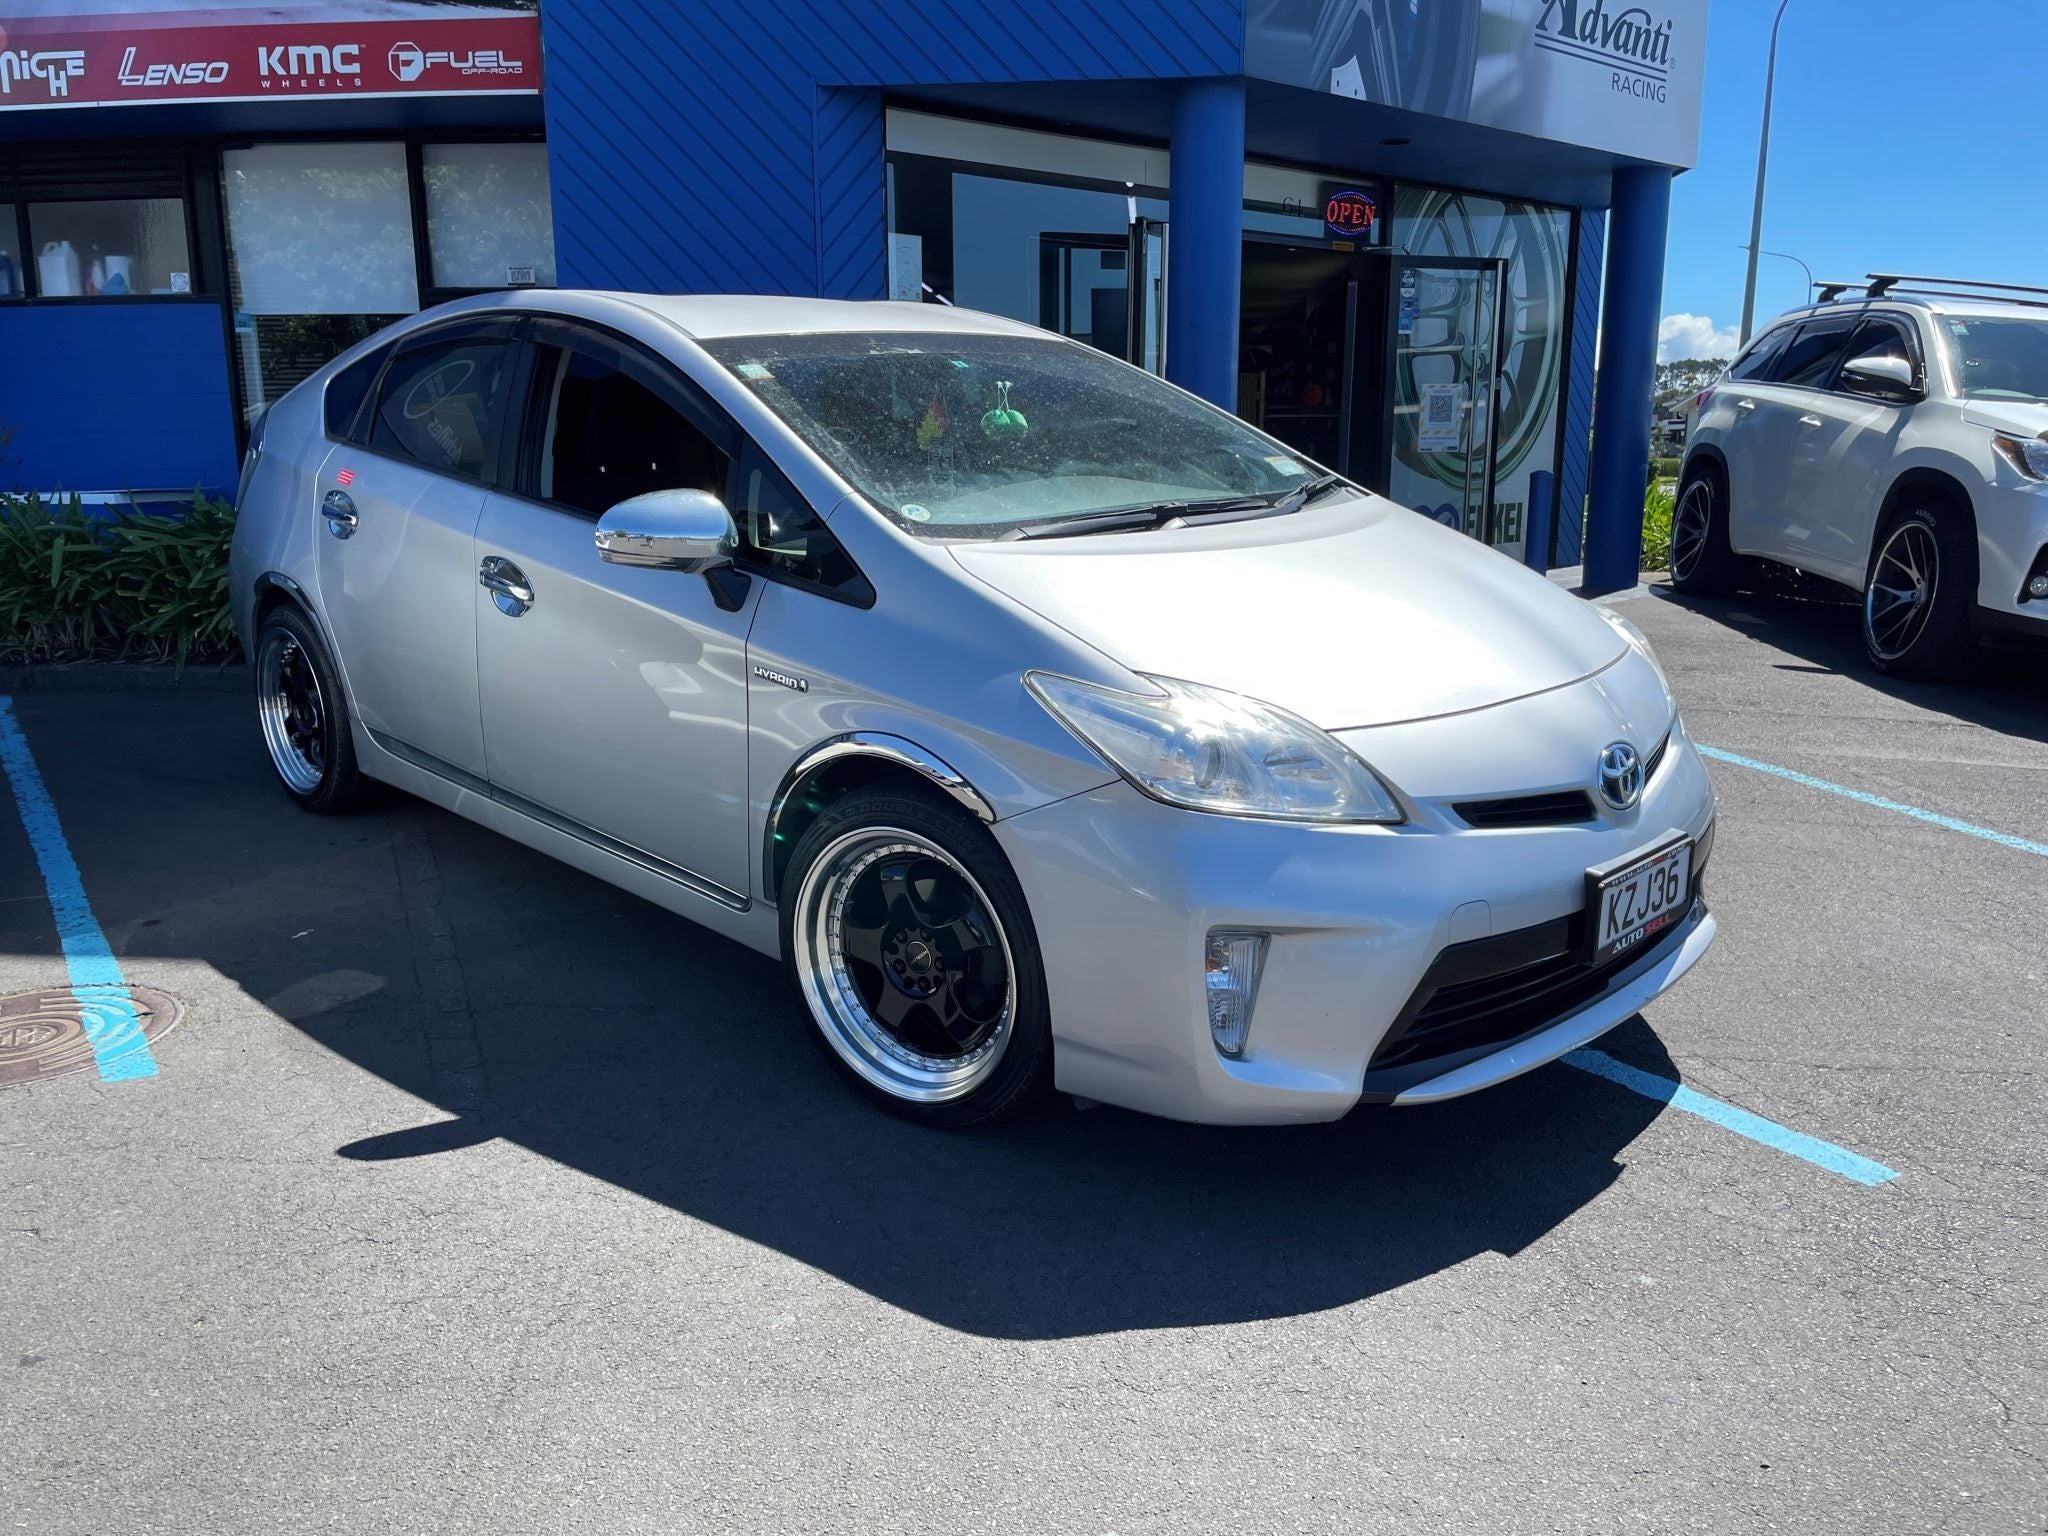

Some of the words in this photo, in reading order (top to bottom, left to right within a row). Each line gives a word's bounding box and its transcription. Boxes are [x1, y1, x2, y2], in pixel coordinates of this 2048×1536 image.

[1536, 0, 1673, 66] Advanti
[118, 47, 229, 86] LENSO
[258, 44, 361, 77] KMC
[425, 50, 523, 69] FUEL
[461, 66, 523, 76] OFF-ROAD
[261, 78, 362, 89] WHEELS
[1611, 72, 1667, 104] RACING
[1326, 200, 1376, 225] OPEN
[1606, 859, 1679, 940] KZJ36
[1612, 927, 1645, 955] AUTO
